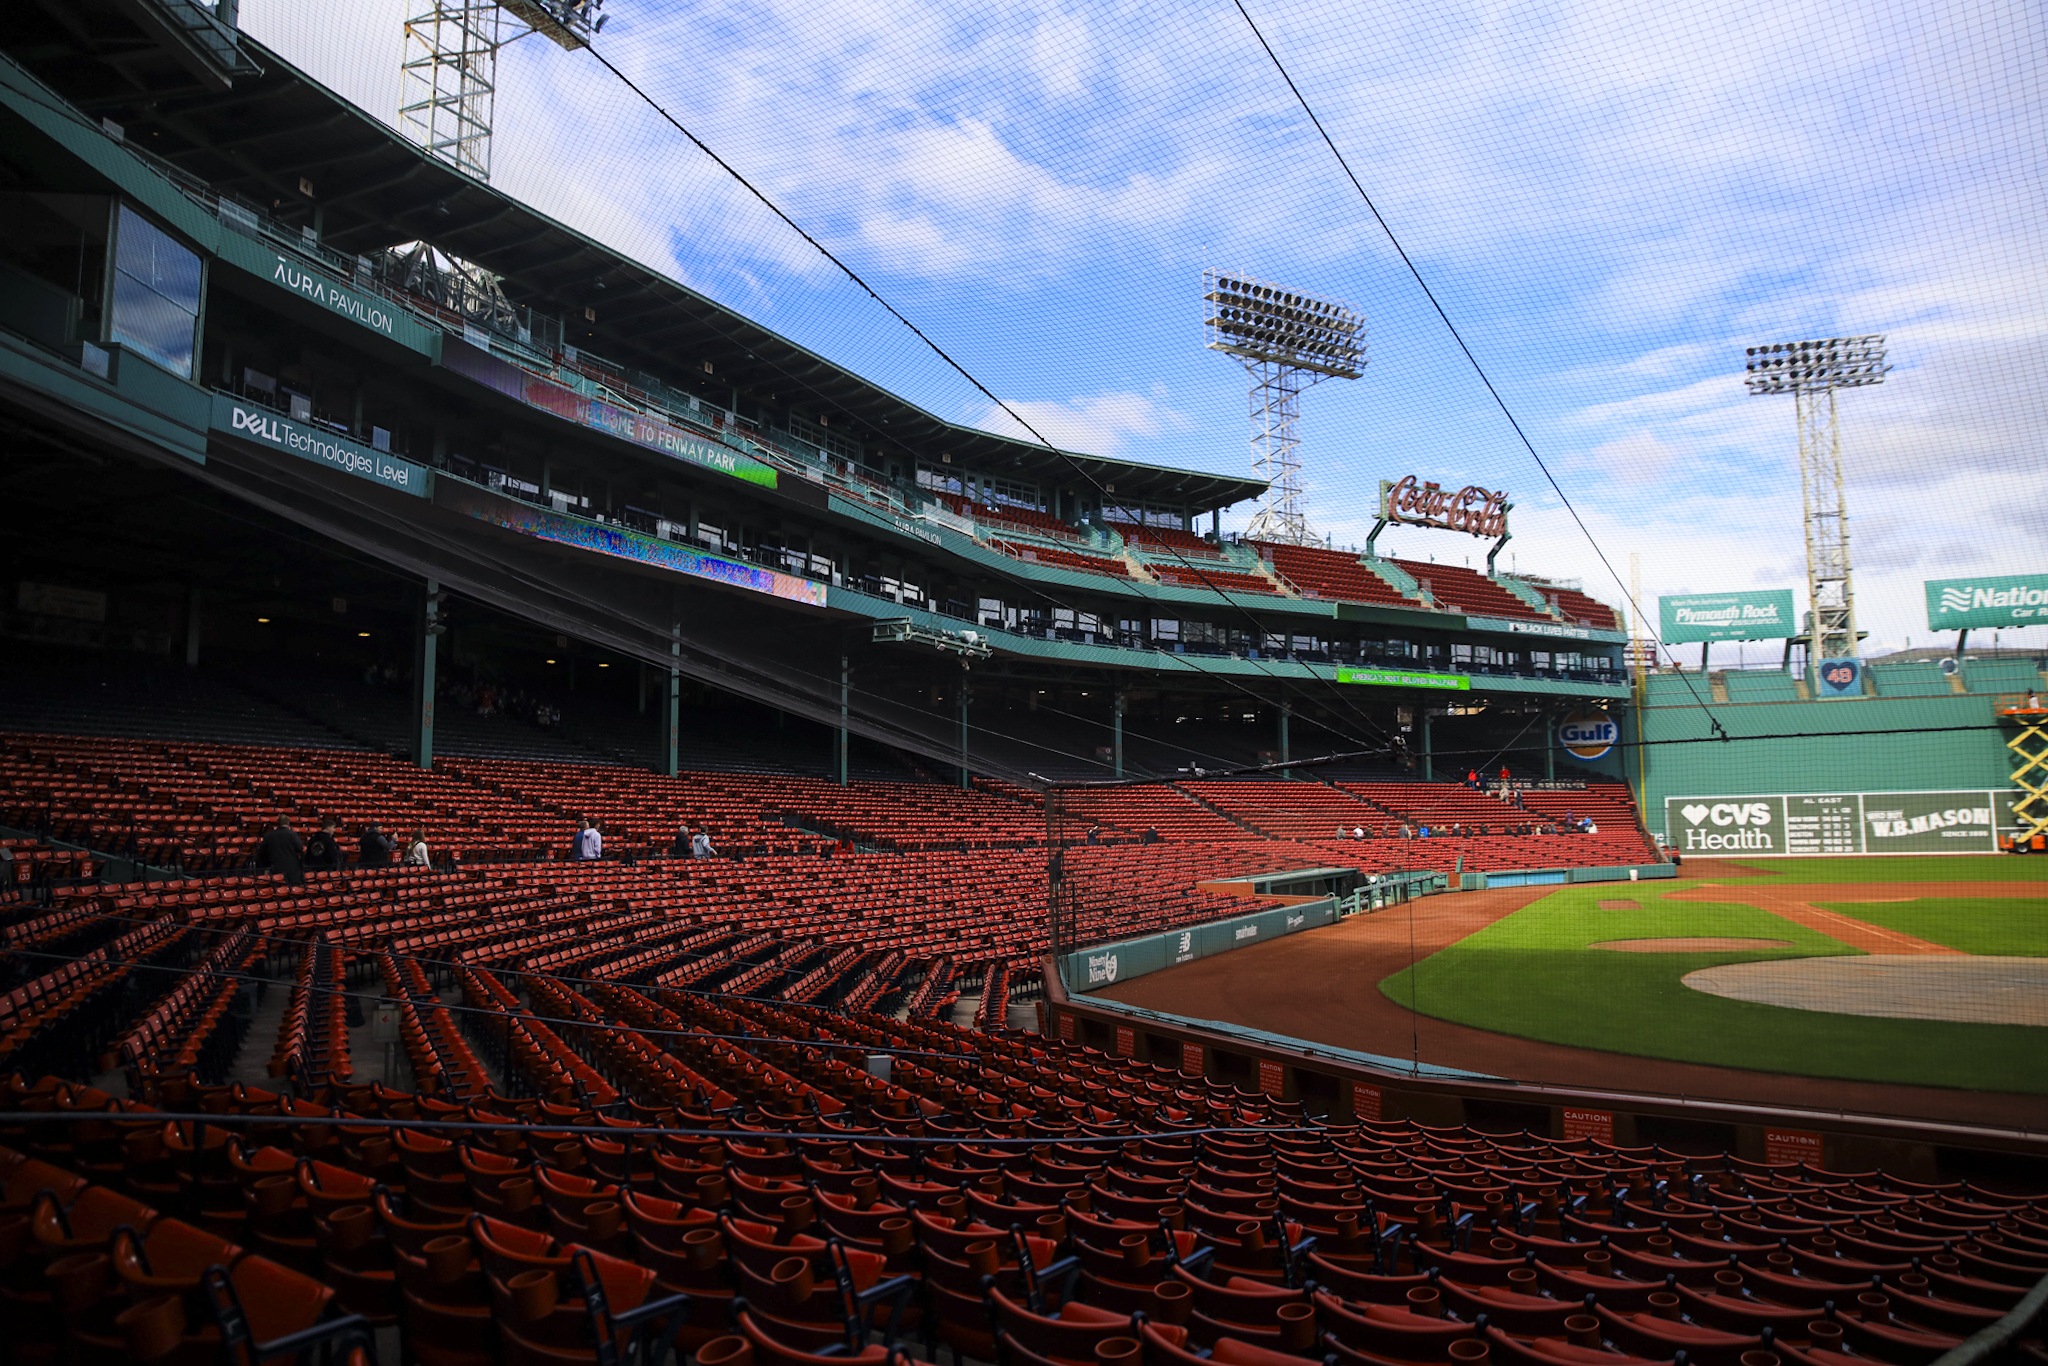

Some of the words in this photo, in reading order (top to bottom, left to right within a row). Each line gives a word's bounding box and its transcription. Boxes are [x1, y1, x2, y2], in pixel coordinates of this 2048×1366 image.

[329, 290, 393, 333] PAVILION
[576, 401, 635, 436] WELCOME
[640, 424, 655, 442] TO
[658, 431, 704, 460] FENWAY
[707, 449, 736, 472] PARK
[232, 407, 282, 443] DELL
[282, 423, 373, 471] Technologies
[375, 458, 409, 485] Level
[1388, 475, 1510, 538] Coca-Cola
[915, 527, 942, 546] PAVILION
[611, 536, 643, 558] MOST
[646, 542, 697, 571] BELOVED
[1676, 606, 1740, 622] Plymouth
[1743, 603, 1779, 618] Rock
[2011, 608, 2035, 617] Car
[1520, 623, 1543, 634] BLACK
[1543, 625, 1563, 636] LIVES
[1563, 628, 1590, 638] MATTER
[1351, 673, 1383, 682] AMERICA'S
[1384, 675, 1400, 683] MOST
[1402, 676, 1428, 685] BELOVED
[1429, 678, 1459, 687] BALLPARK
[1560, 724, 1613, 742] Gulf
[1710, 803, 1772, 826] CVS
[1685, 828, 1774, 850] Health
[1941, 830, 1968, 838] SINCE
[18, 873, 31, 881] 133
[1088, 956, 1107, 968] Ninety
[1089, 967, 1107, 983] Nine
[1259, 1062, 1283, 1073] CAUTION!
[1354, 1086, 1381, 1097] CAUTION!
[1564, 1111, 1612, 1123] CAUTION!
[1767, 1133, 1820, 1146] CAUTION!
